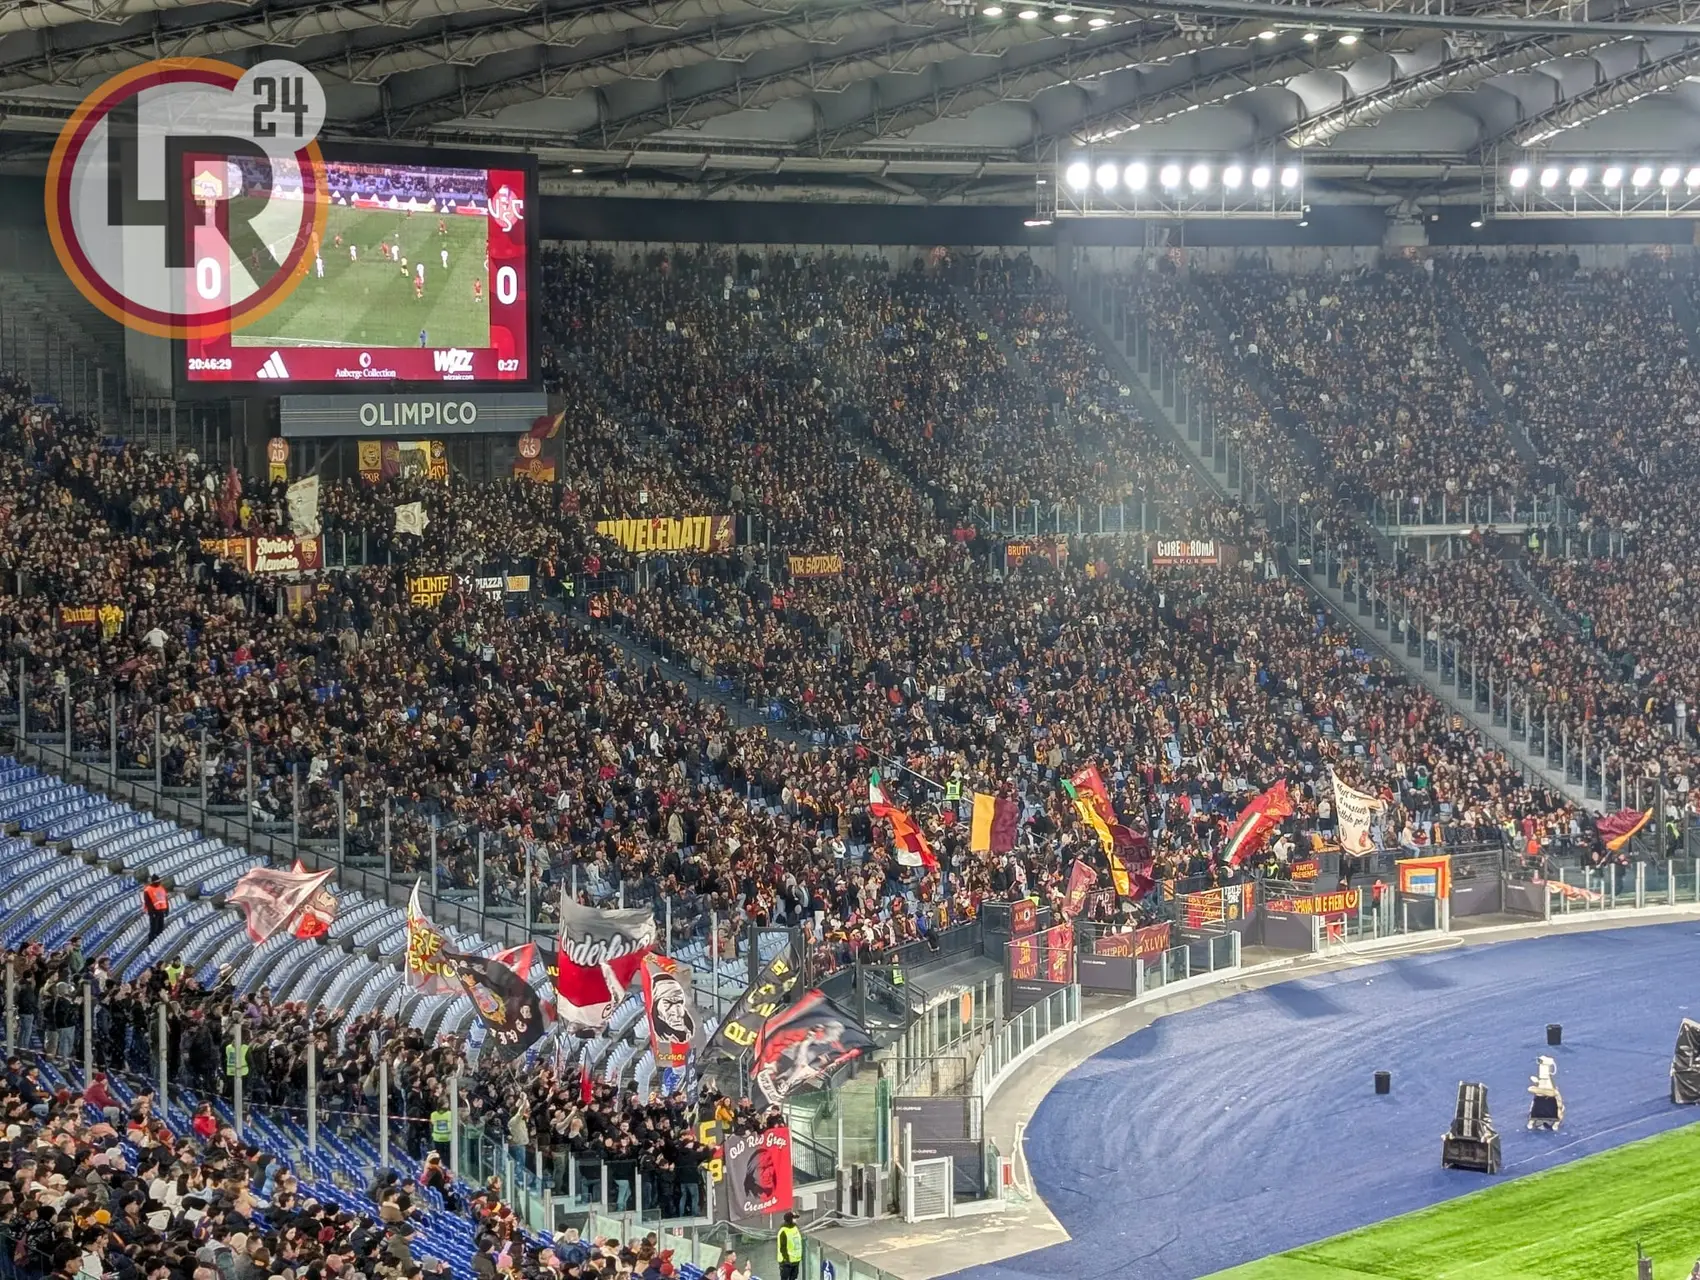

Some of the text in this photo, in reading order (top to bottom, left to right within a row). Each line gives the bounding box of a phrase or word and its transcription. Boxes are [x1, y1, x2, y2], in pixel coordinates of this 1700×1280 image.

[196, 257, 222, 300] 0
[496, 265, 518, 305] 0
[335, 368, 396, 379] Auberge Collection
[497, 359, 519, 372] 0:27
[359, 402, 477, 427] OLIMPICO
[271, 449, 285, 462] AD
[523, 444, 535, 456] AS
[255, 555, 300, 572] Memoria
[410, 575, 449, 593] MONTE
[475, 577, 503, 589] PIAZZA
[729, 1132, 787, 1159] Old Red Grey
[743, 1196, 778, 1212] Cremona
